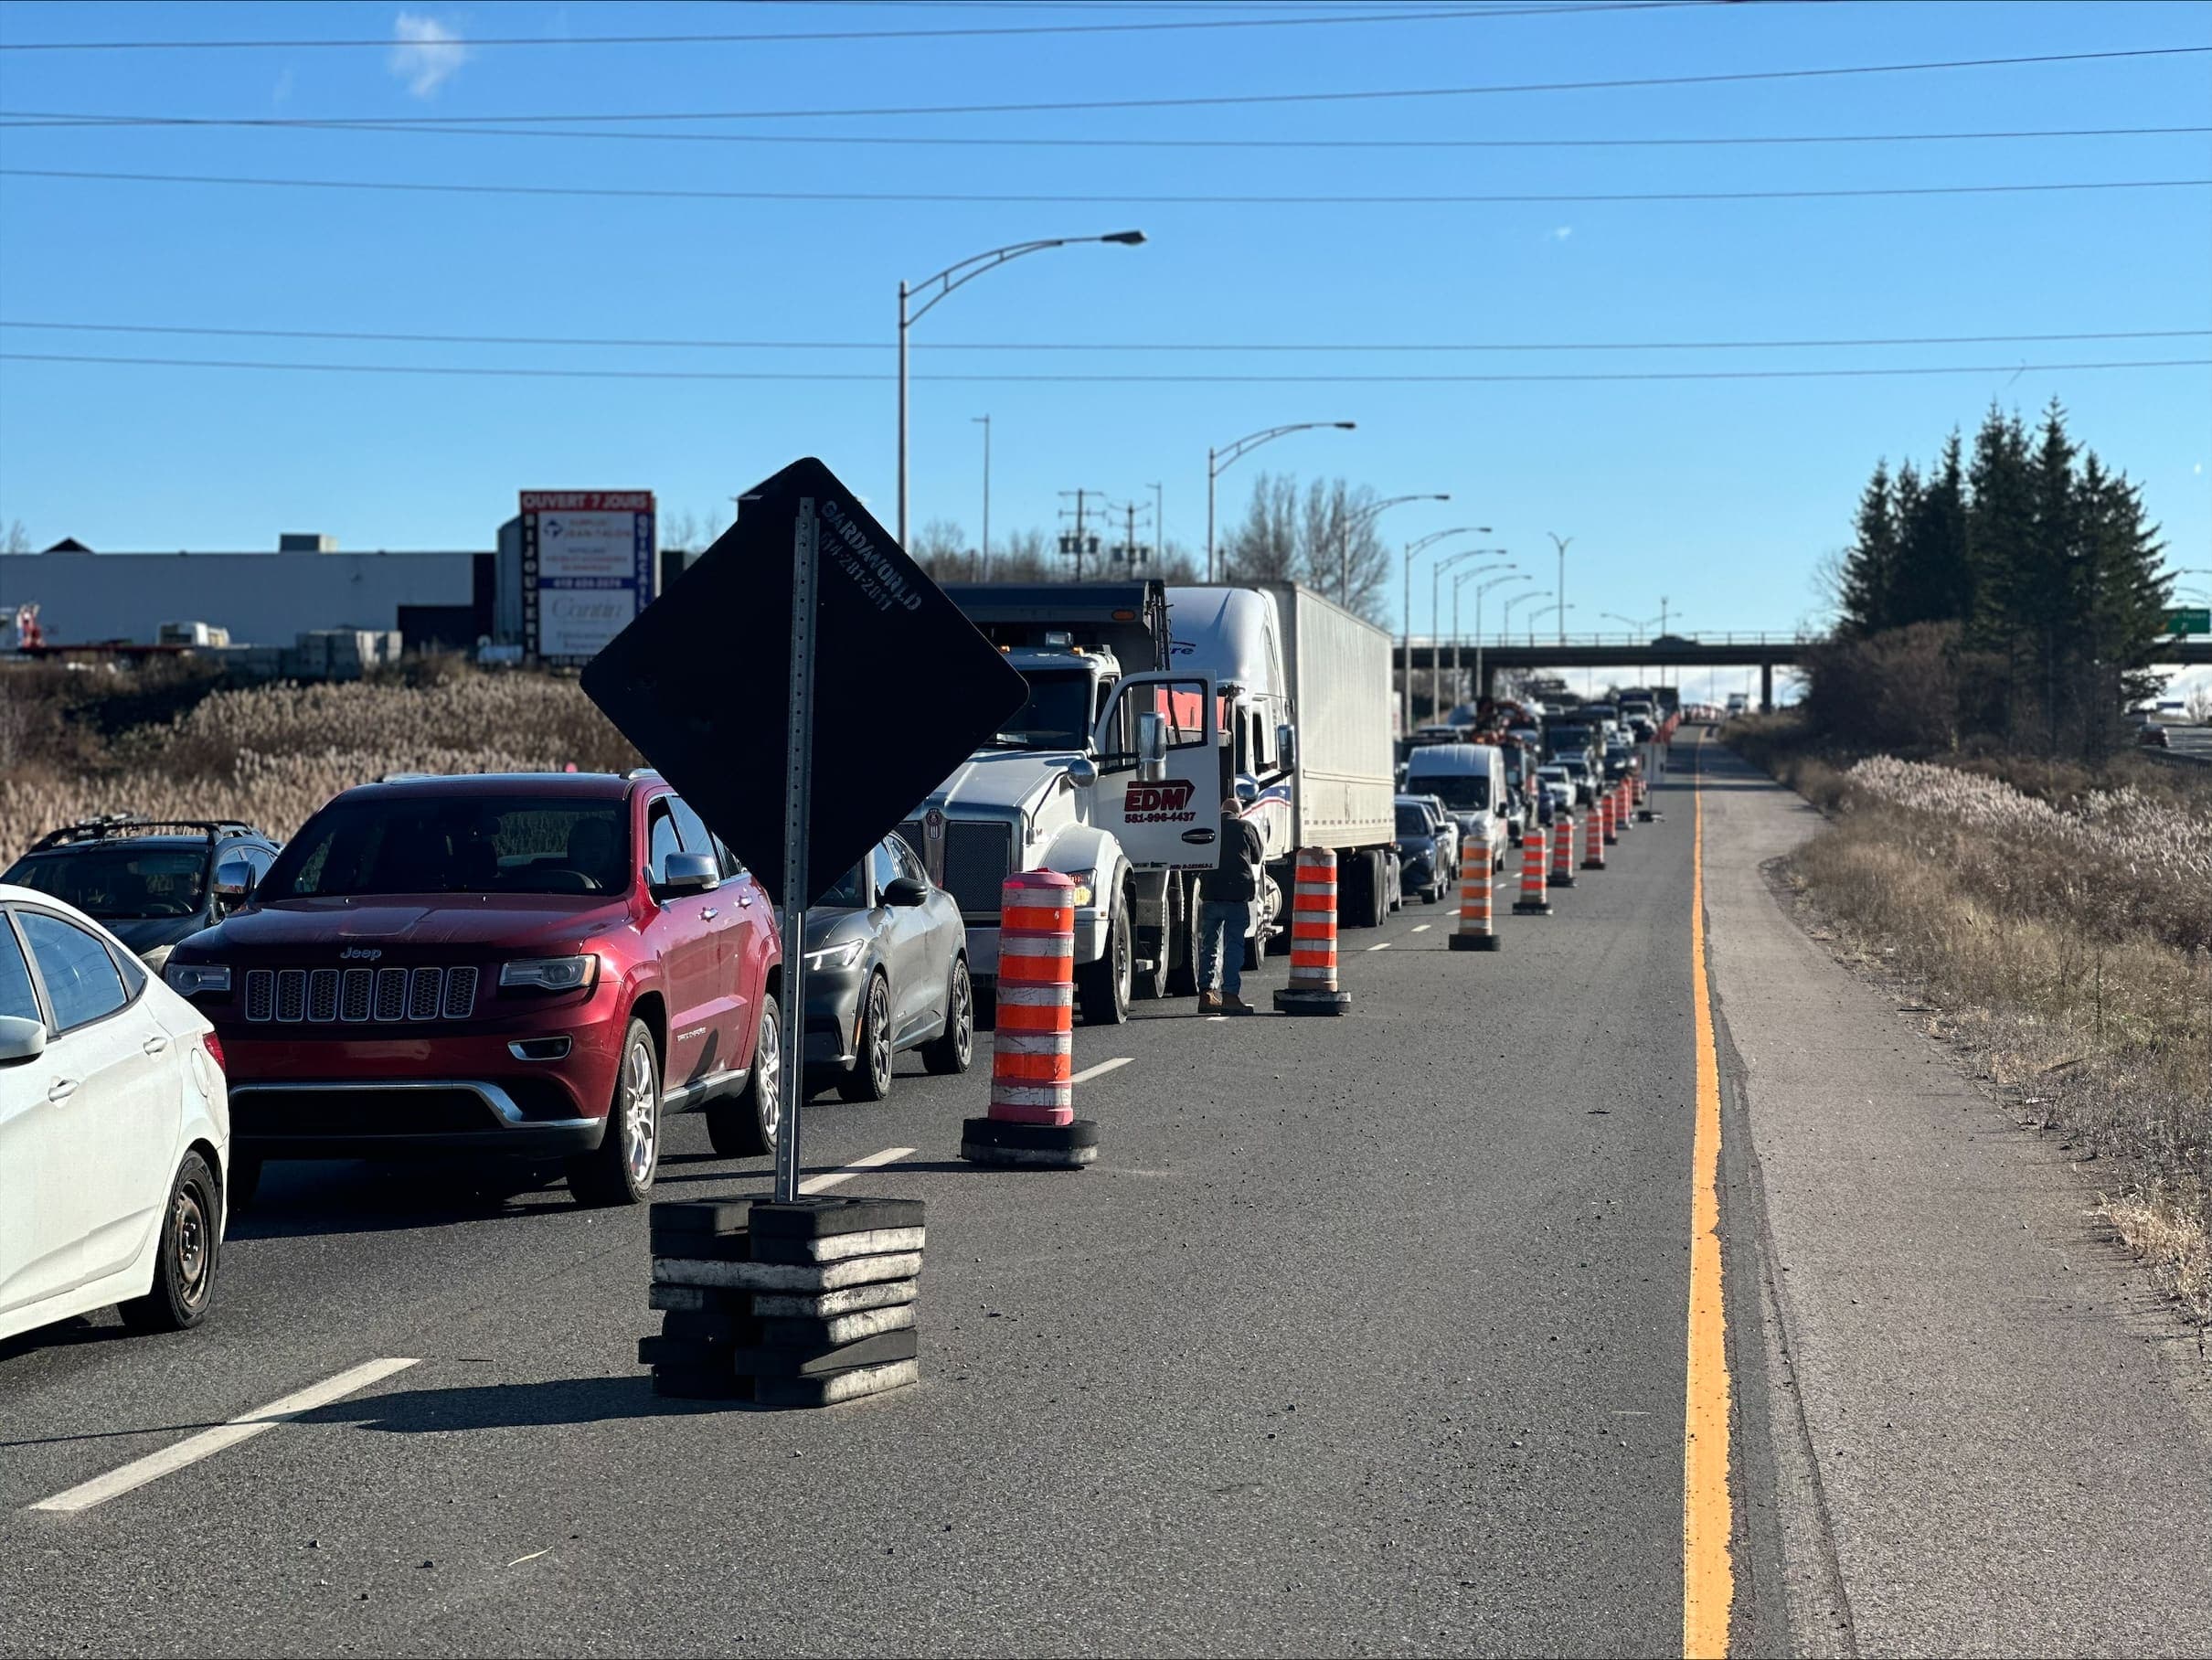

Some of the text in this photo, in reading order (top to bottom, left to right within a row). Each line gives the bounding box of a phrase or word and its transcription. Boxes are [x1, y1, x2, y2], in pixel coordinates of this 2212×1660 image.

[524, 495, 647, 507] OUVERT 7 JOURS
[822, 500, 922, 611] GARDAWORLD
[1124, 788, 1186, 812] EDM
[339, 945, 382, 962] Jeep
